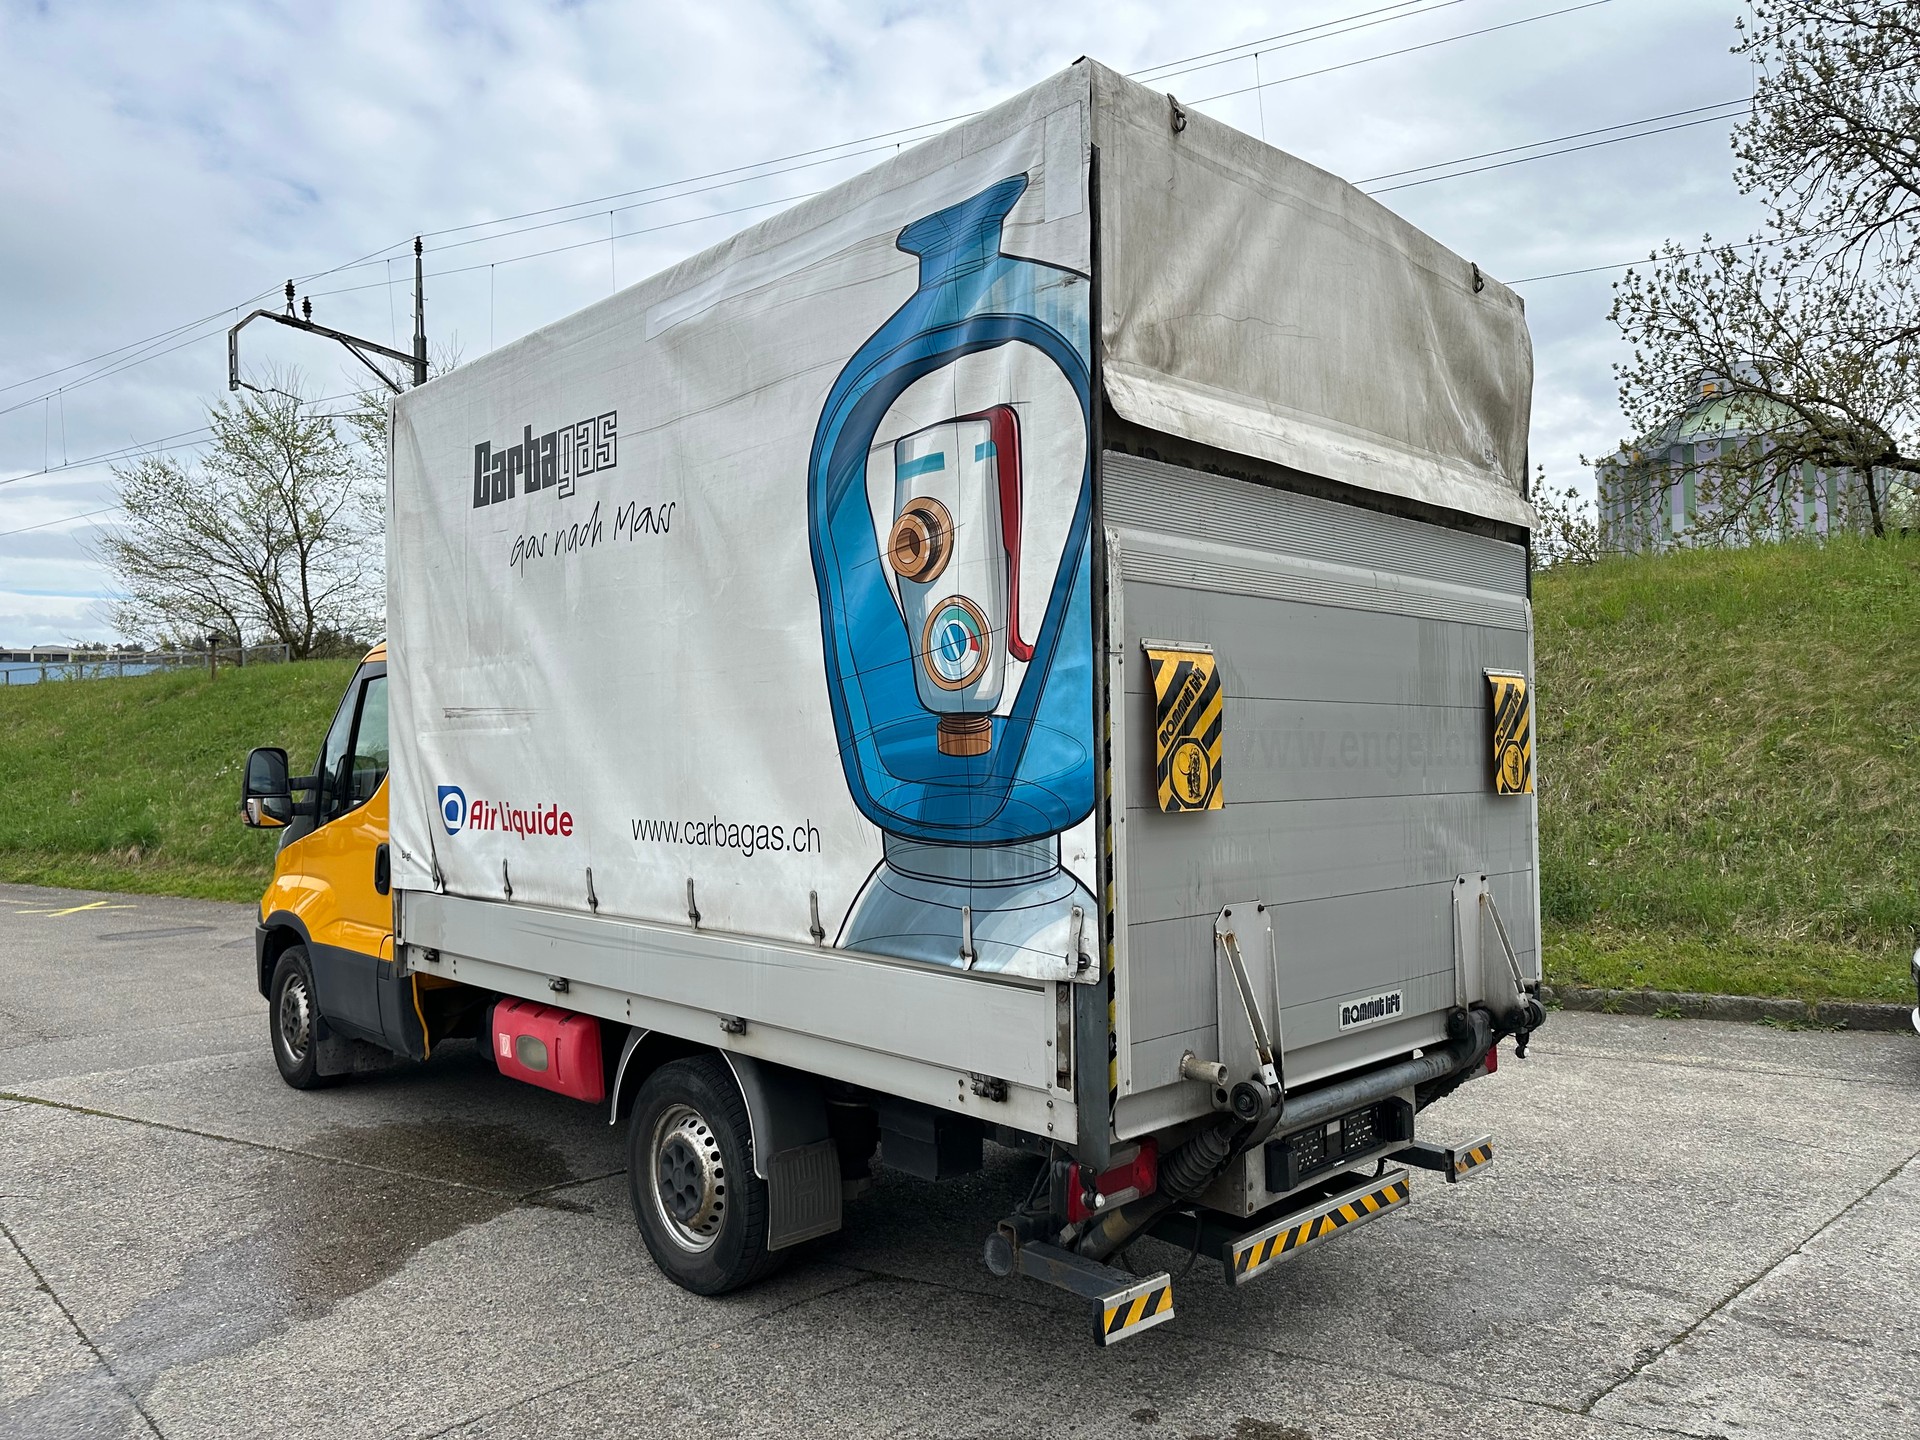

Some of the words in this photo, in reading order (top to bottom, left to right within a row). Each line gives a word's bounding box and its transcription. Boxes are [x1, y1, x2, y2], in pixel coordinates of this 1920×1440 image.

[473, 409, 617, 509] Carbagas
[554, 500, 602, 556] nach
[613, 500, 676, 542] Mass
[1159, 686, 1195, 748] mammut
[469, 800, 497, 830] Air
[499, 801, 573, 841] Liquide
[631, 815, 821, 858] www.carbagas.ch
[1342, 997, 1384, 1026] mammut
[1385, 993, 1400, 1015] lift
